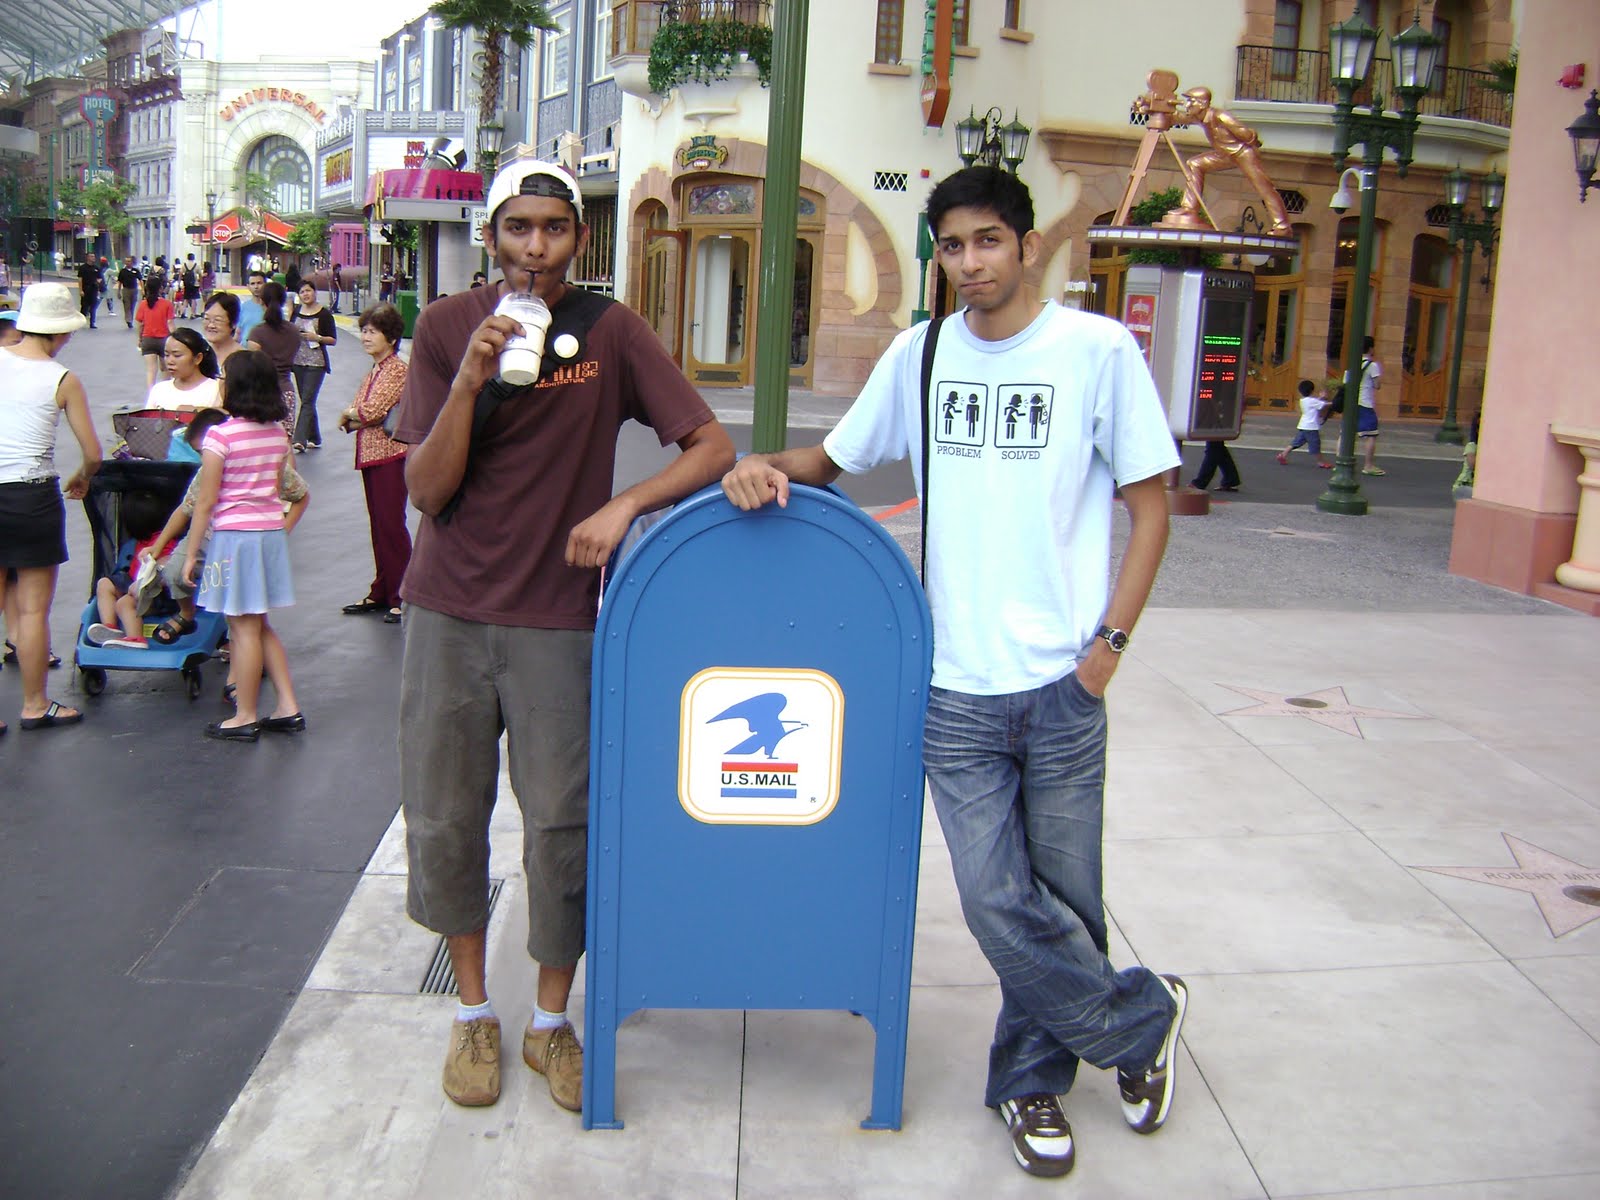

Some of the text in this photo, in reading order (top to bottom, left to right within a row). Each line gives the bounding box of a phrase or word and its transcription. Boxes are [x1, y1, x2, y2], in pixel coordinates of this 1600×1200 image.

[84, 97, 114, 112] HOTEL
[219, 87, 327, 125] UNIVERSAL
[95, 109, 105, 168] EMPIRE
[215, 229, 231, 238] STOP
[534, 377, 586, 389] ARCHITECTURE
[936, 445, 982, 459] PROBLEM
[1001, 450, 1041, 460] SOLVED
[1482, 871, 1557, 880] ROBERT
